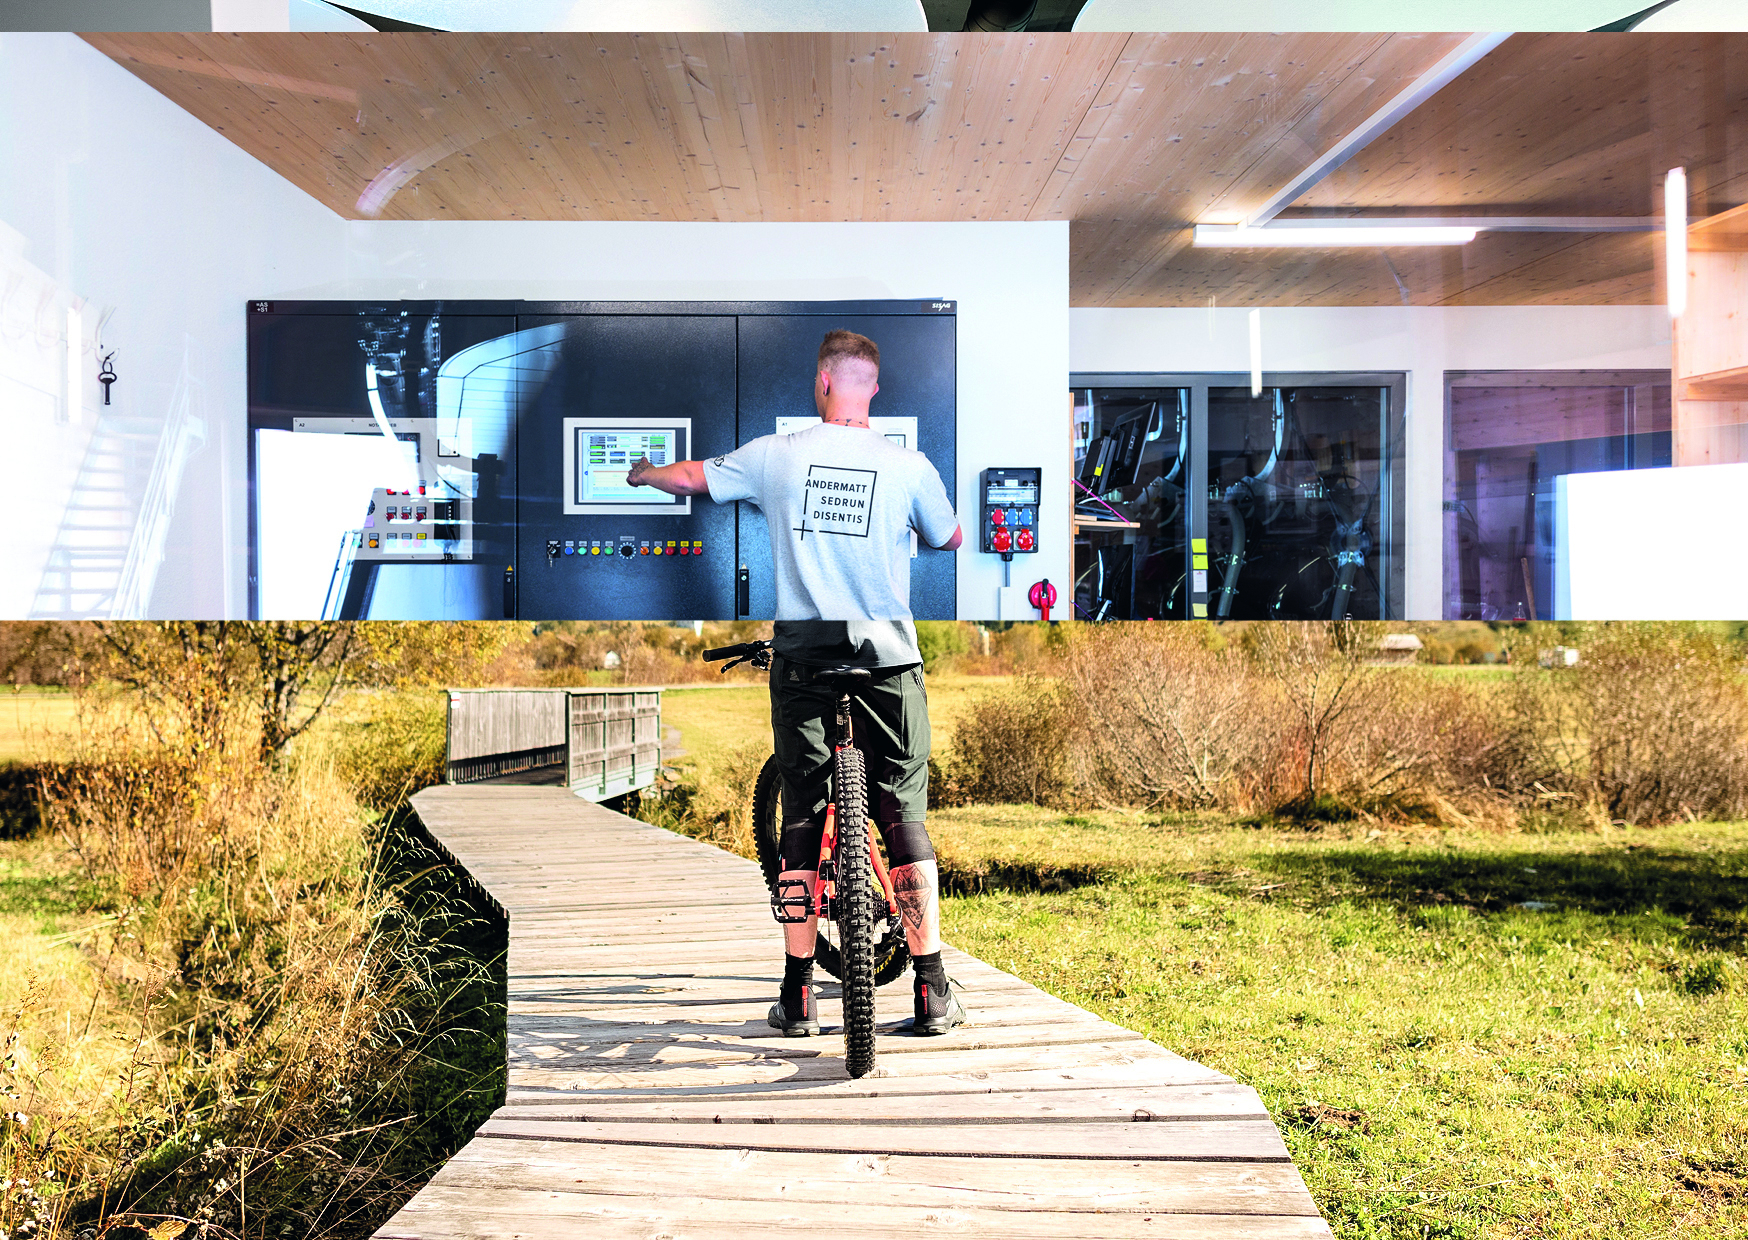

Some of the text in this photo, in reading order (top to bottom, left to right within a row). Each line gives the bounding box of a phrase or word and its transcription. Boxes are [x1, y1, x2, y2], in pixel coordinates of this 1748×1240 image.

[805, 479, 867, 494] ANDERMATT
[820, 496, 865, 509] SEDRUN
[813, 510, 863, 524] DISENTIS
